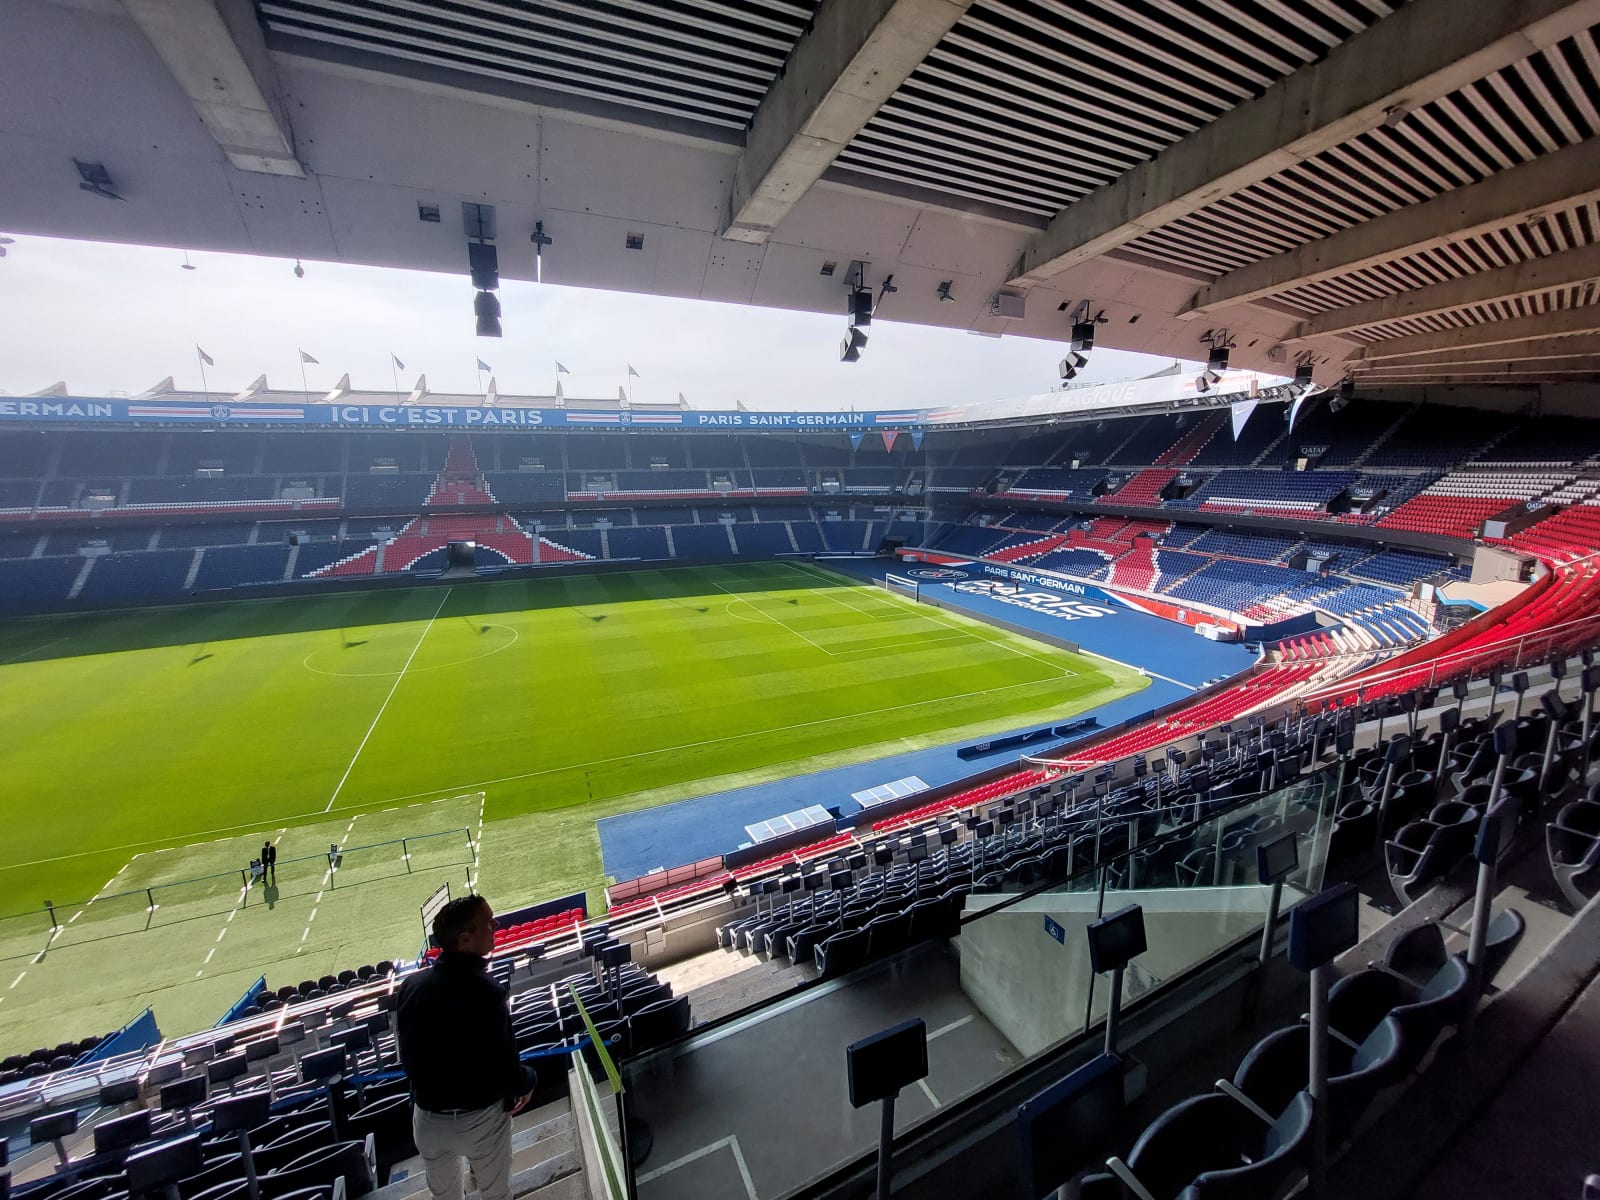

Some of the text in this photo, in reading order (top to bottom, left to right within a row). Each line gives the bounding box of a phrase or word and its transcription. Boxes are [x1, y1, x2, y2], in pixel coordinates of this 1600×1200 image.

[332, 406, 543, 425] ICI C'EST PARIS
[699, 413, 864, 425] PARIS SAINT-GERMAIN
[984, 565, 1086, 595] PARIS SAINT-GERMAIN
